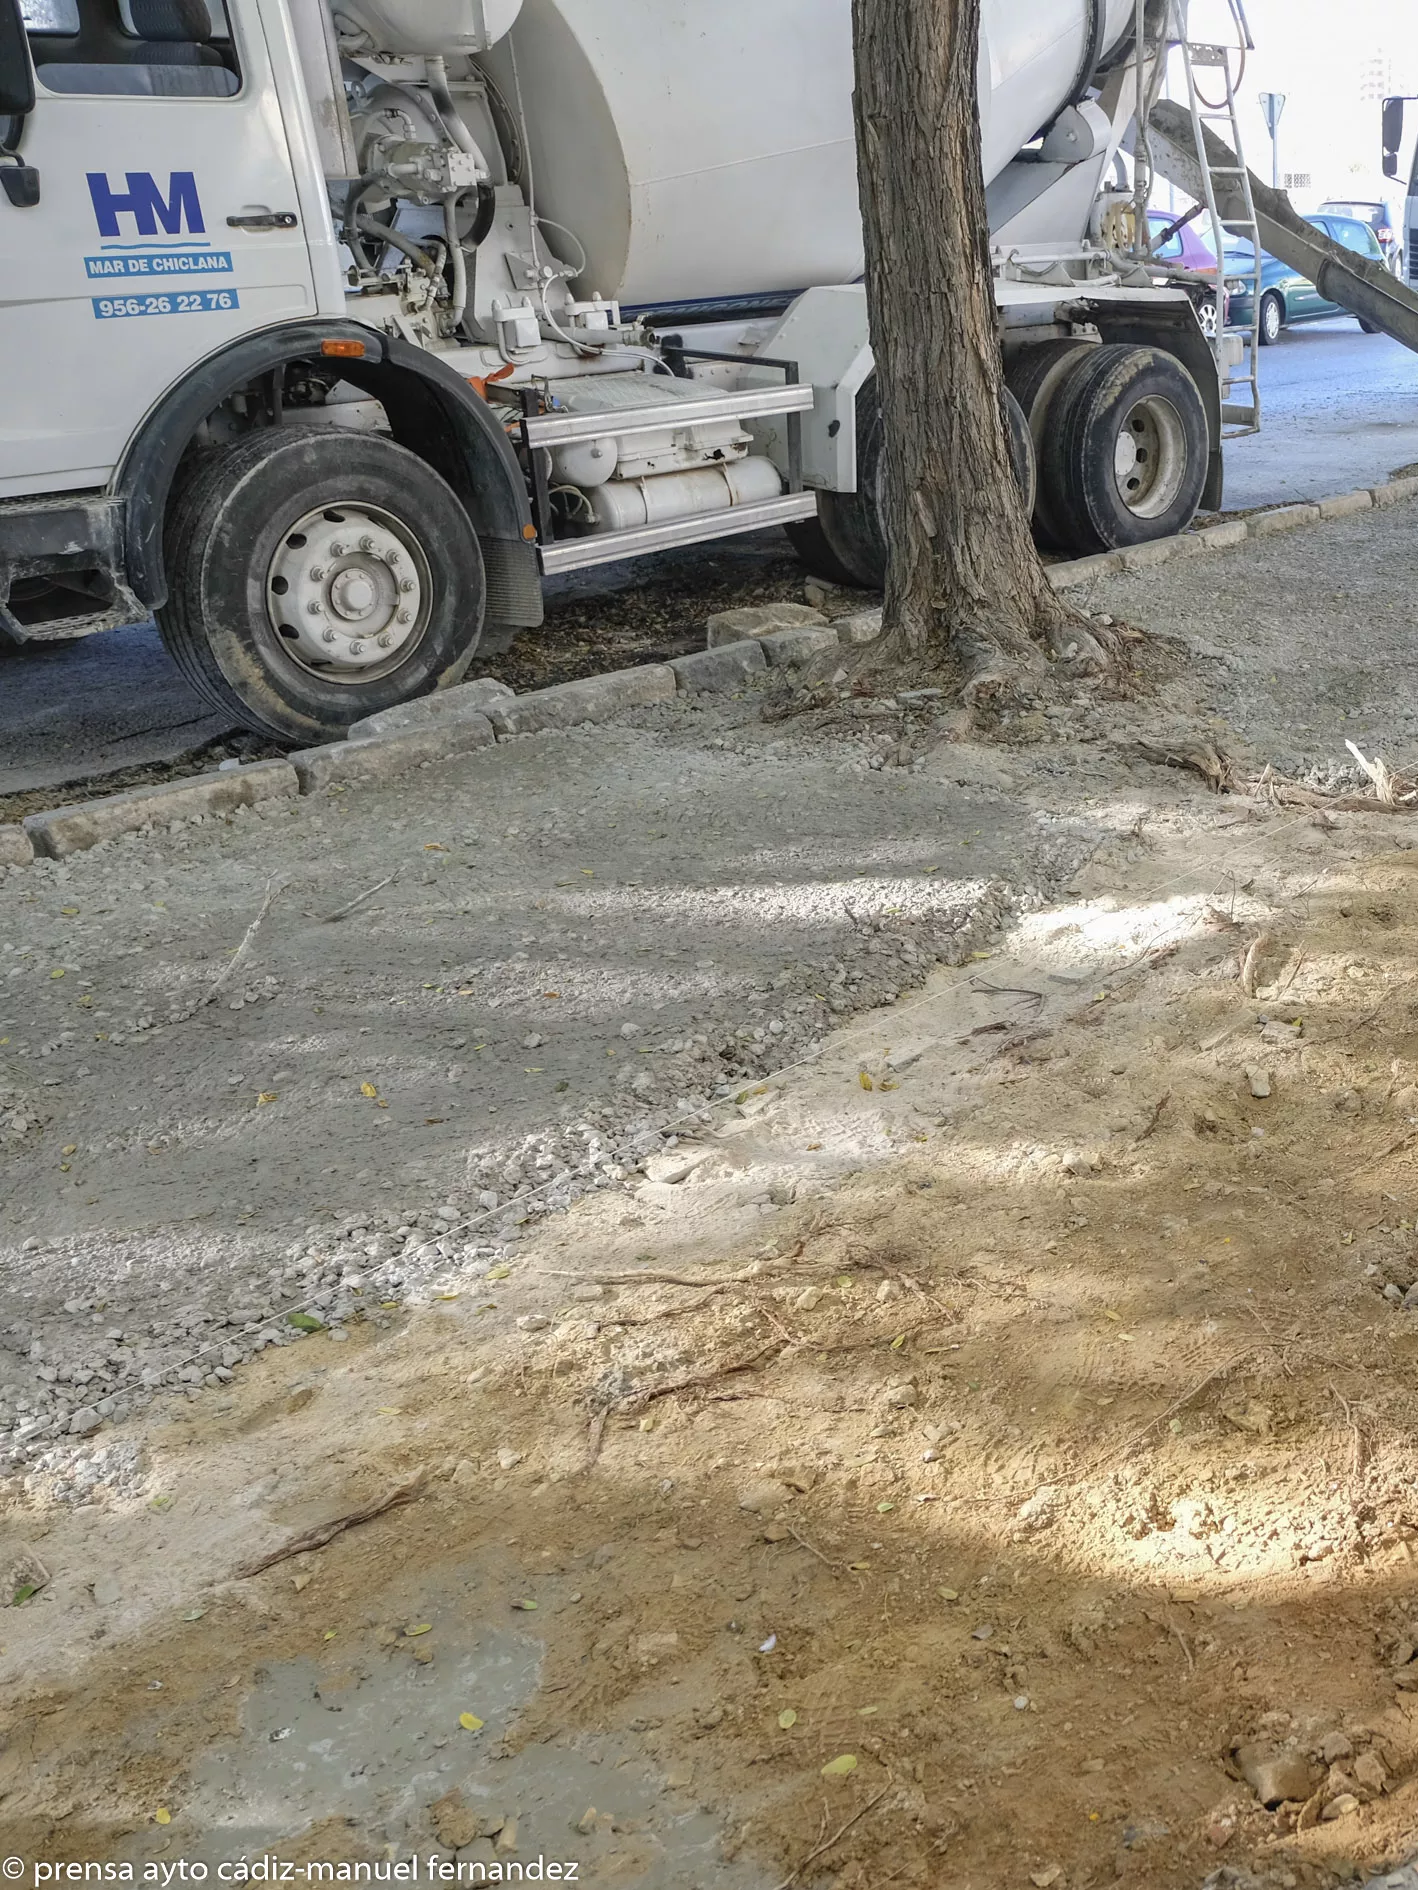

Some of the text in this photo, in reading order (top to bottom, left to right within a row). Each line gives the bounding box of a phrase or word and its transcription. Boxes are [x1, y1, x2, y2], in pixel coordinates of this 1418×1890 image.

[86, 172, 205, 237] HM
[89, 256, 228, 274] MAR DE CHICLANA
[99, 293, 232, 317] 956-26 22 76
